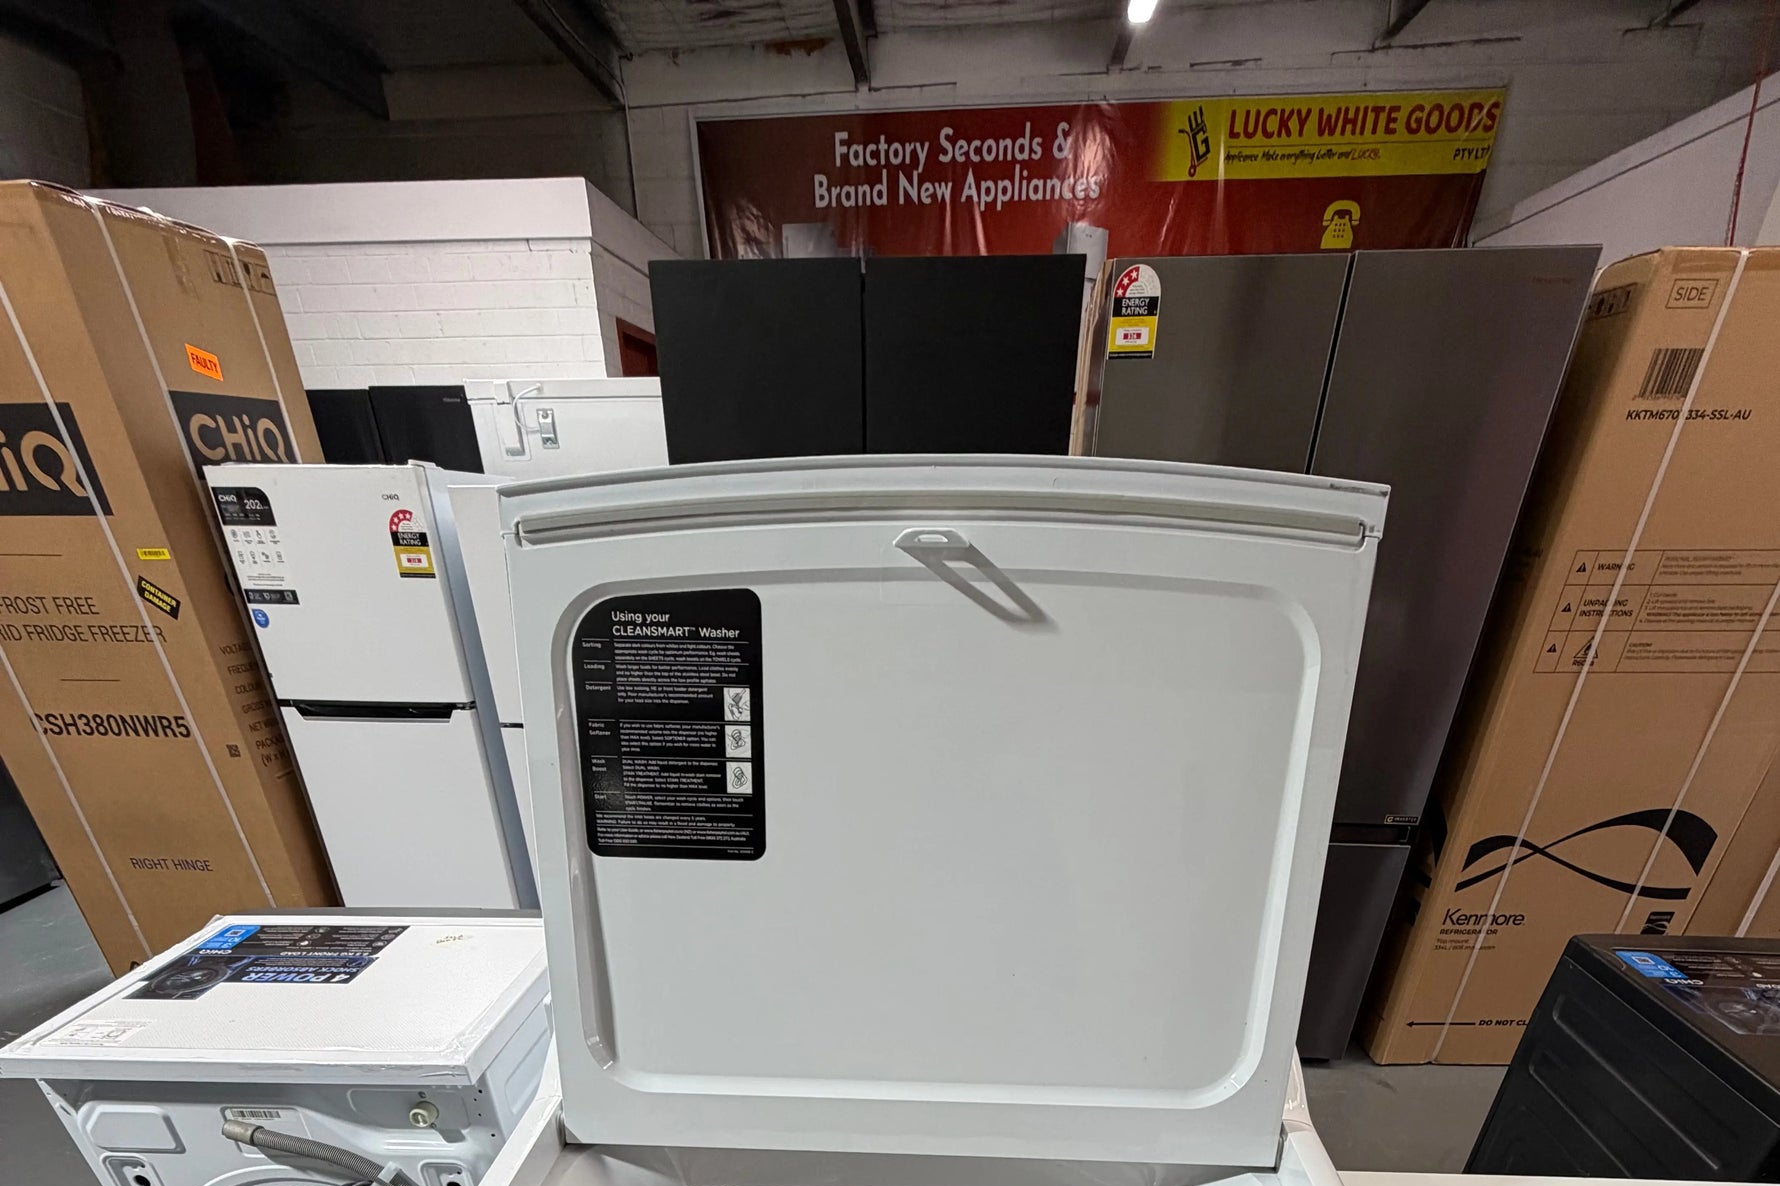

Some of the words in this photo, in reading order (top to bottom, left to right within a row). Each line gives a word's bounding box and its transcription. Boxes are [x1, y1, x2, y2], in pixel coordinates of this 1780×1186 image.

[1228, 107, 1311, 140] LUCKY
[1317, 105, 1402, 137] WHITE
[1405, 101, 1501, 135] GOODS
[834, 131, 929, 173] Factory
[939, 122, 1043, 163] Seconds
[1053, 121, 1072, 159] &
[814, 169, 888, 208] Brand
[899, 170, 952, 205] New
[961, 164, 1100, 212] Appliances
[1674, 286, 1710, 301] SIDE
[1121, 298, 1150, 307] ENERGY
[1121, 307, 1148, 316] RATING
[190, 352, 220, 375] FAULTY
[189, 413, 290, 463] CHiQ
[141, 580, 177, 607] CONTAINER
[144, 590, 172, 613] DAMAGE
[52, 597, 100, 615] FREE
[611, 611, 642, 623] Using
[645, 613, 670, 623] your
[22, 624, 91, 642] FRIDGE
[90, 625, 168, 643] FREEZER
[699, 627, 740, 638] Washer
[583, 663, 606, 671] Loading
[249, 720, 262, 732] NET
[130, 857, 171, 871] RIGHT
[173, 858, 214, 872] HINGE
[1442, 908, 1525, 926] Kenmore
[241, 973, 329, 982] POWER
[333, 973, 350, 982] 4
